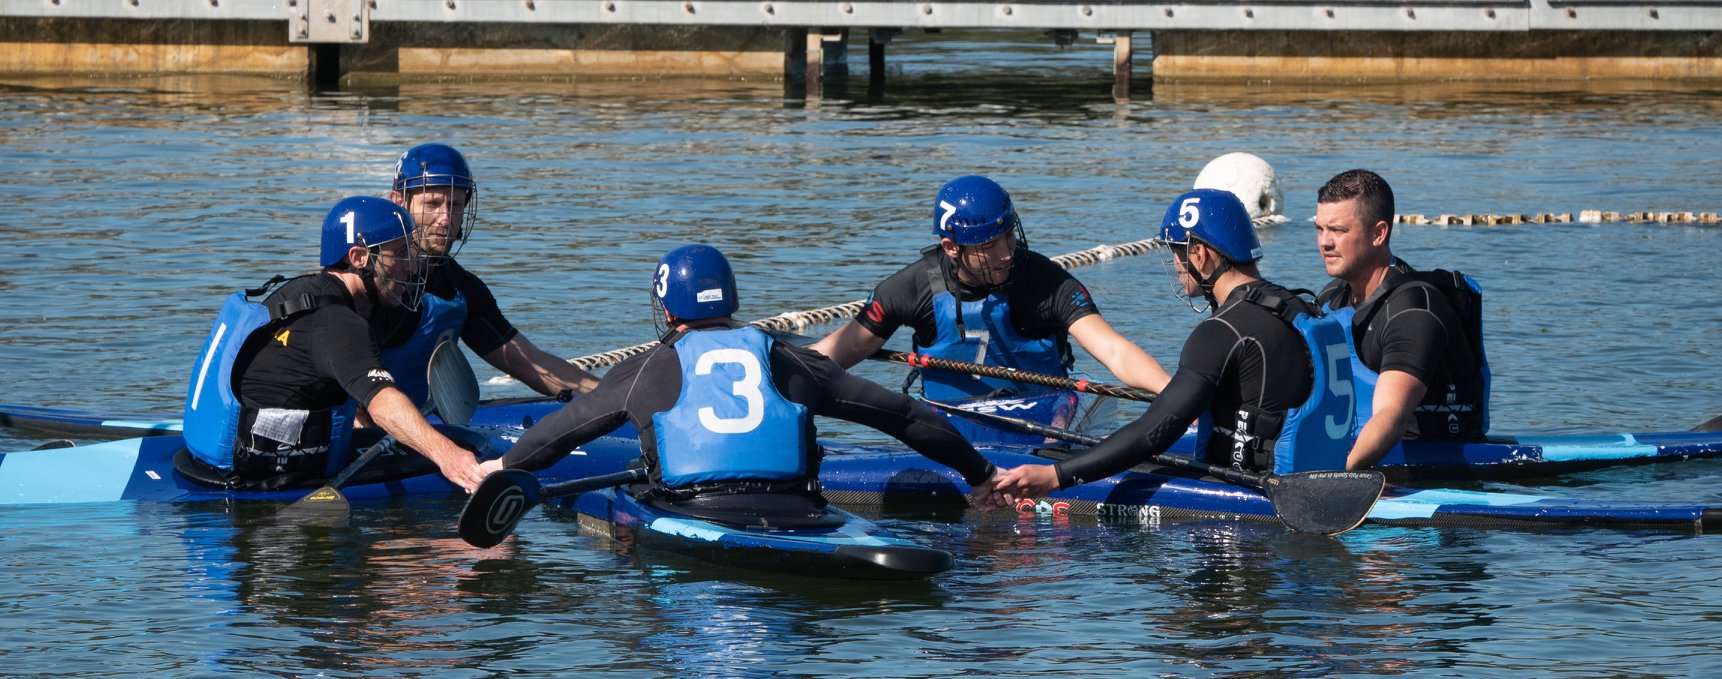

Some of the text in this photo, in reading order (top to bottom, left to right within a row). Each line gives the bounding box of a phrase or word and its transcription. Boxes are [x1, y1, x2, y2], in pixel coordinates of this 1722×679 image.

[340, 211, 355, 244] 1
[939, 200, 957, 231] 7
[1178, 197, 1201, 228] 5
[656, 263, 670, 298] 3
[191, 322, 227, 411] 1
[962, 330, 990, 380] 7
[695, 348, 765, 434] 3
[1325, 343, 1354, 440] 5
